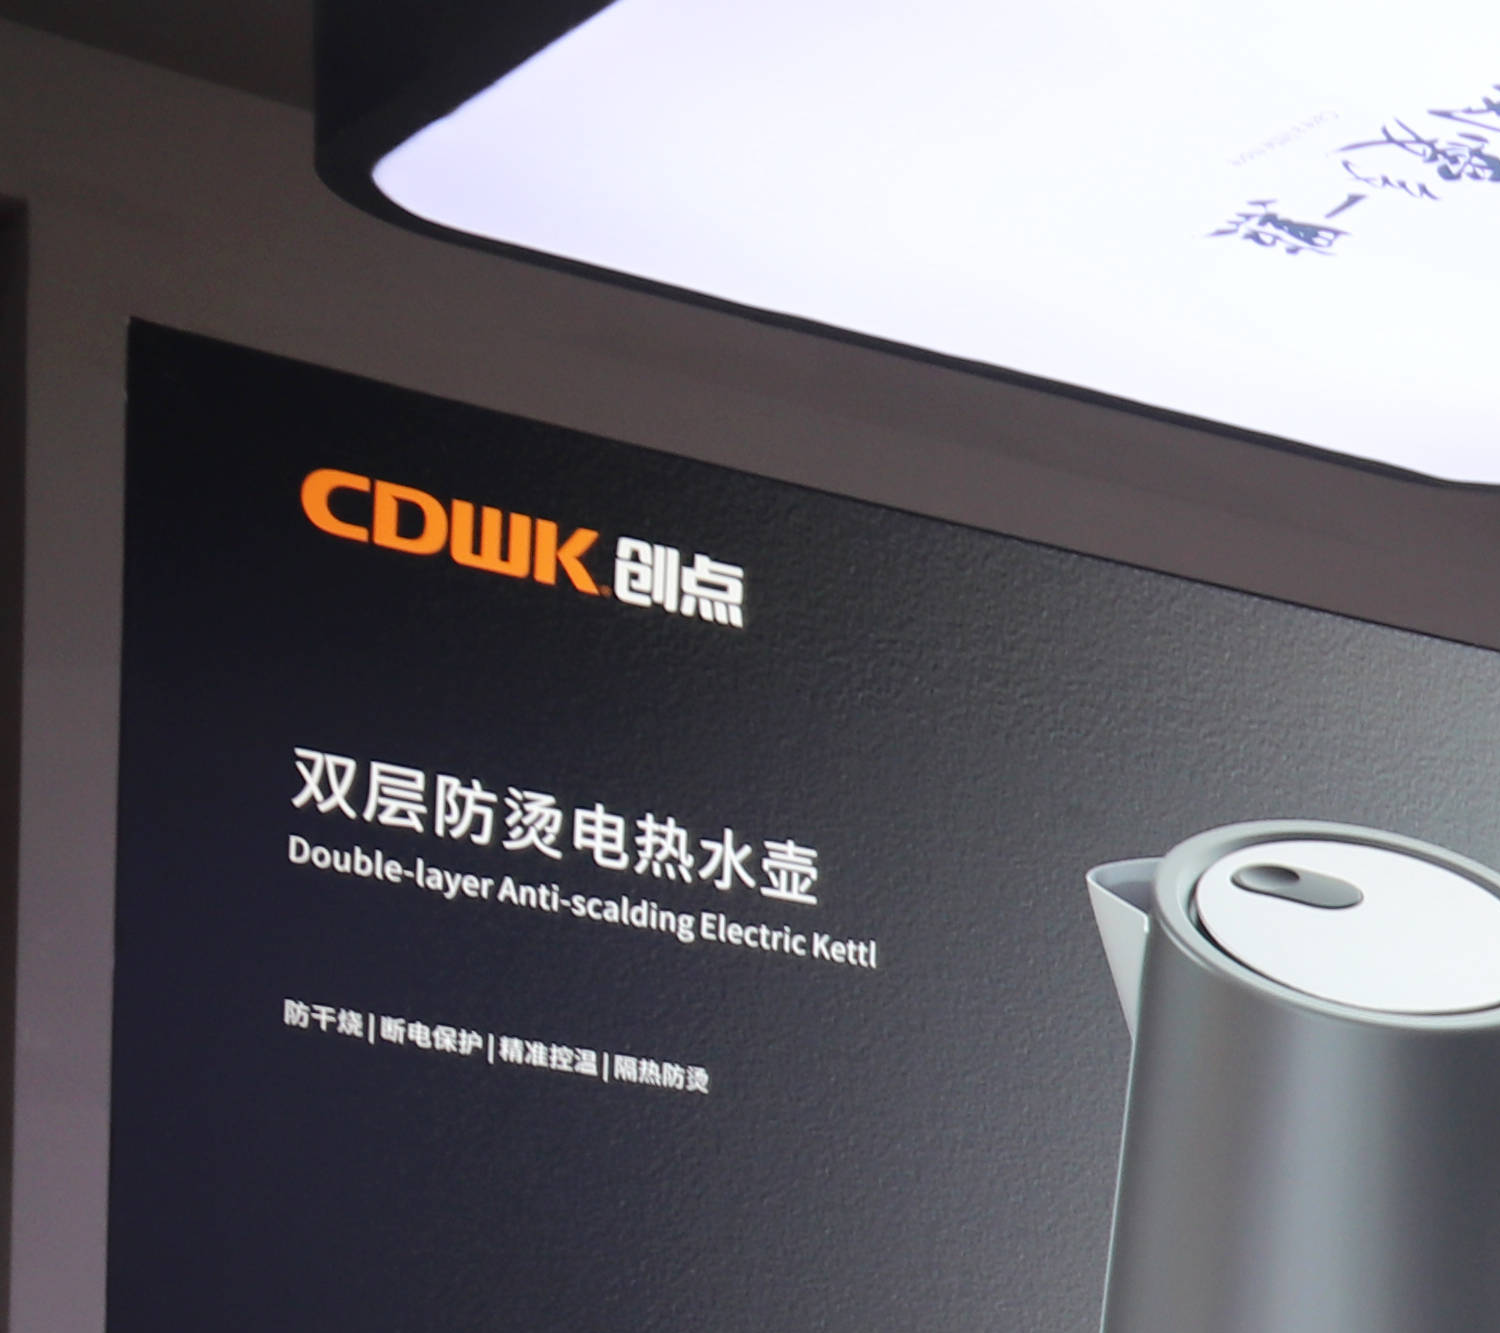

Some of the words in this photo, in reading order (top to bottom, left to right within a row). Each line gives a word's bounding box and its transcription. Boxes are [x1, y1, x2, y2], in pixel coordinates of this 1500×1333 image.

[300, 467, 600, 597] CDWK
[613, 536, 745, 628] 创点
[287, 833, 494, 903] Double-layer
[498, 874, 696, 945] Anti-scalding
[701, 909, 807, 957] Electric
[812, 931, 878, 969] Kettl
[292, 746, 820, 906] 双层防烫电热水壶
